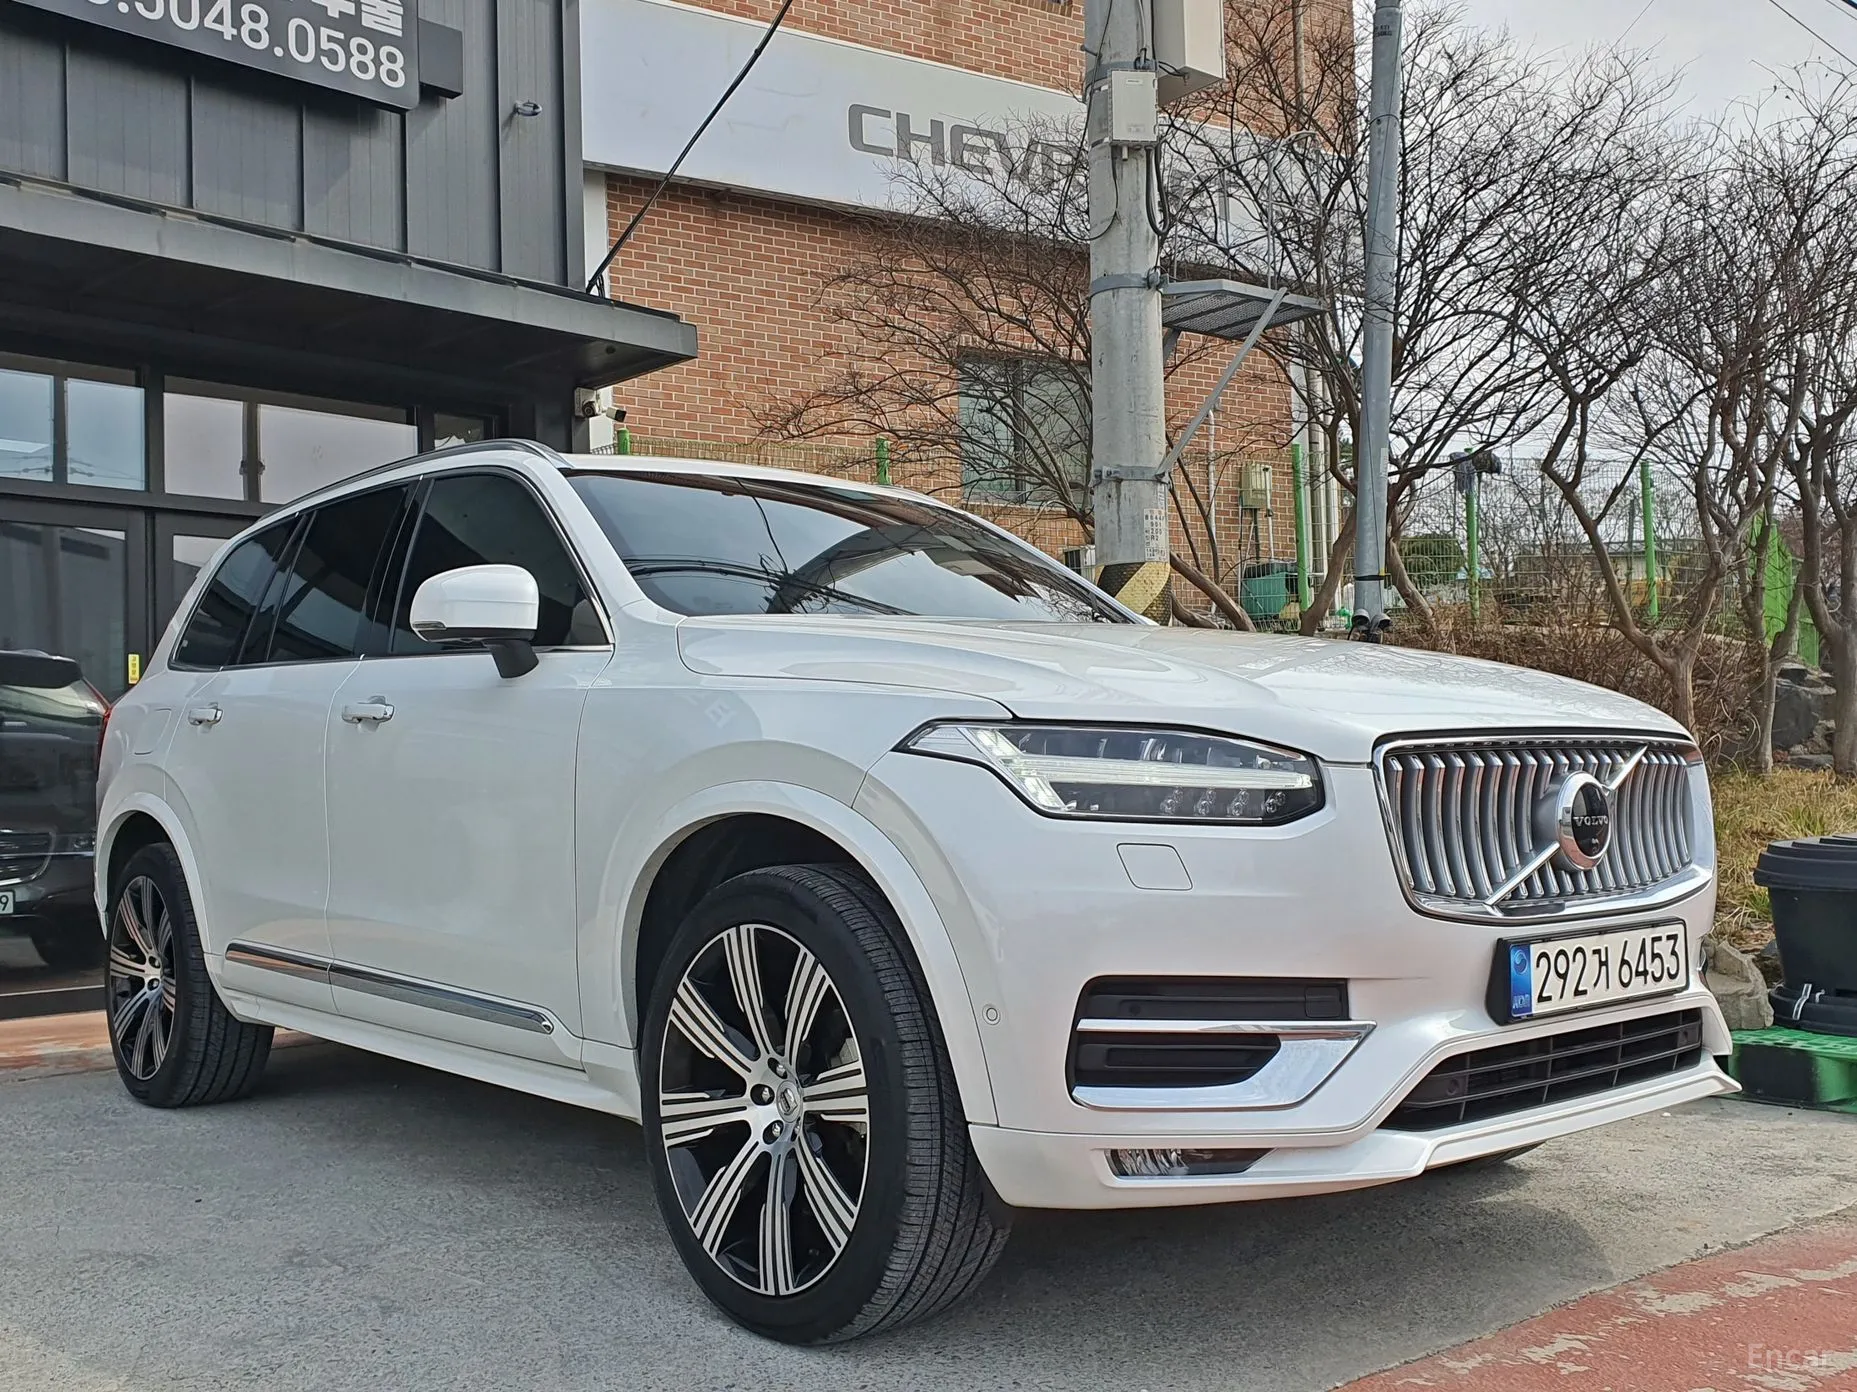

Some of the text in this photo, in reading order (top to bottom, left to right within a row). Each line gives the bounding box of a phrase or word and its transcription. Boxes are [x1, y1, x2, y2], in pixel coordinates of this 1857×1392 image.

[89, 0, 406, 89] .048.0588
[1573, 815, 1608, 827] VOLVO
[1536, 933, 1680, 1003] 292거 6453
